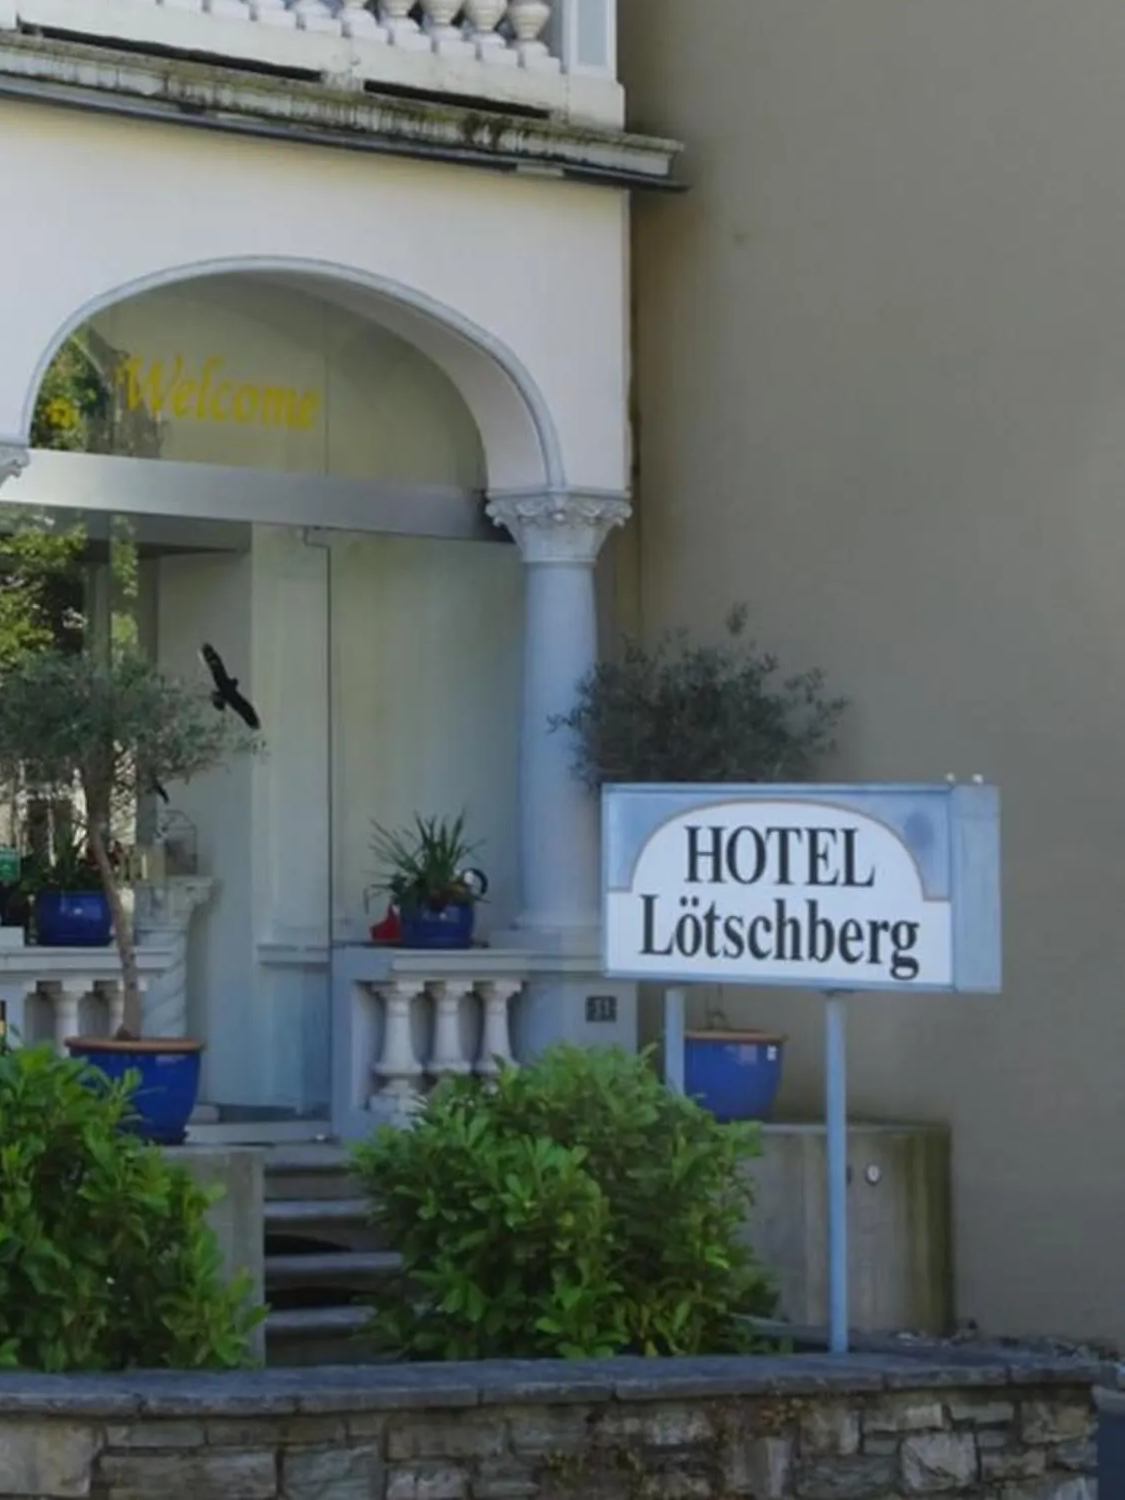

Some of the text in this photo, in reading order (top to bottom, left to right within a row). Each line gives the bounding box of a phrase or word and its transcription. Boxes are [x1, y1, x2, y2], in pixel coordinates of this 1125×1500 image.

[114, 354, 321, 430] Welcome
[684, 825, 875, 887] HOTEL
[639, 893, 920, 980] Lötschberg
